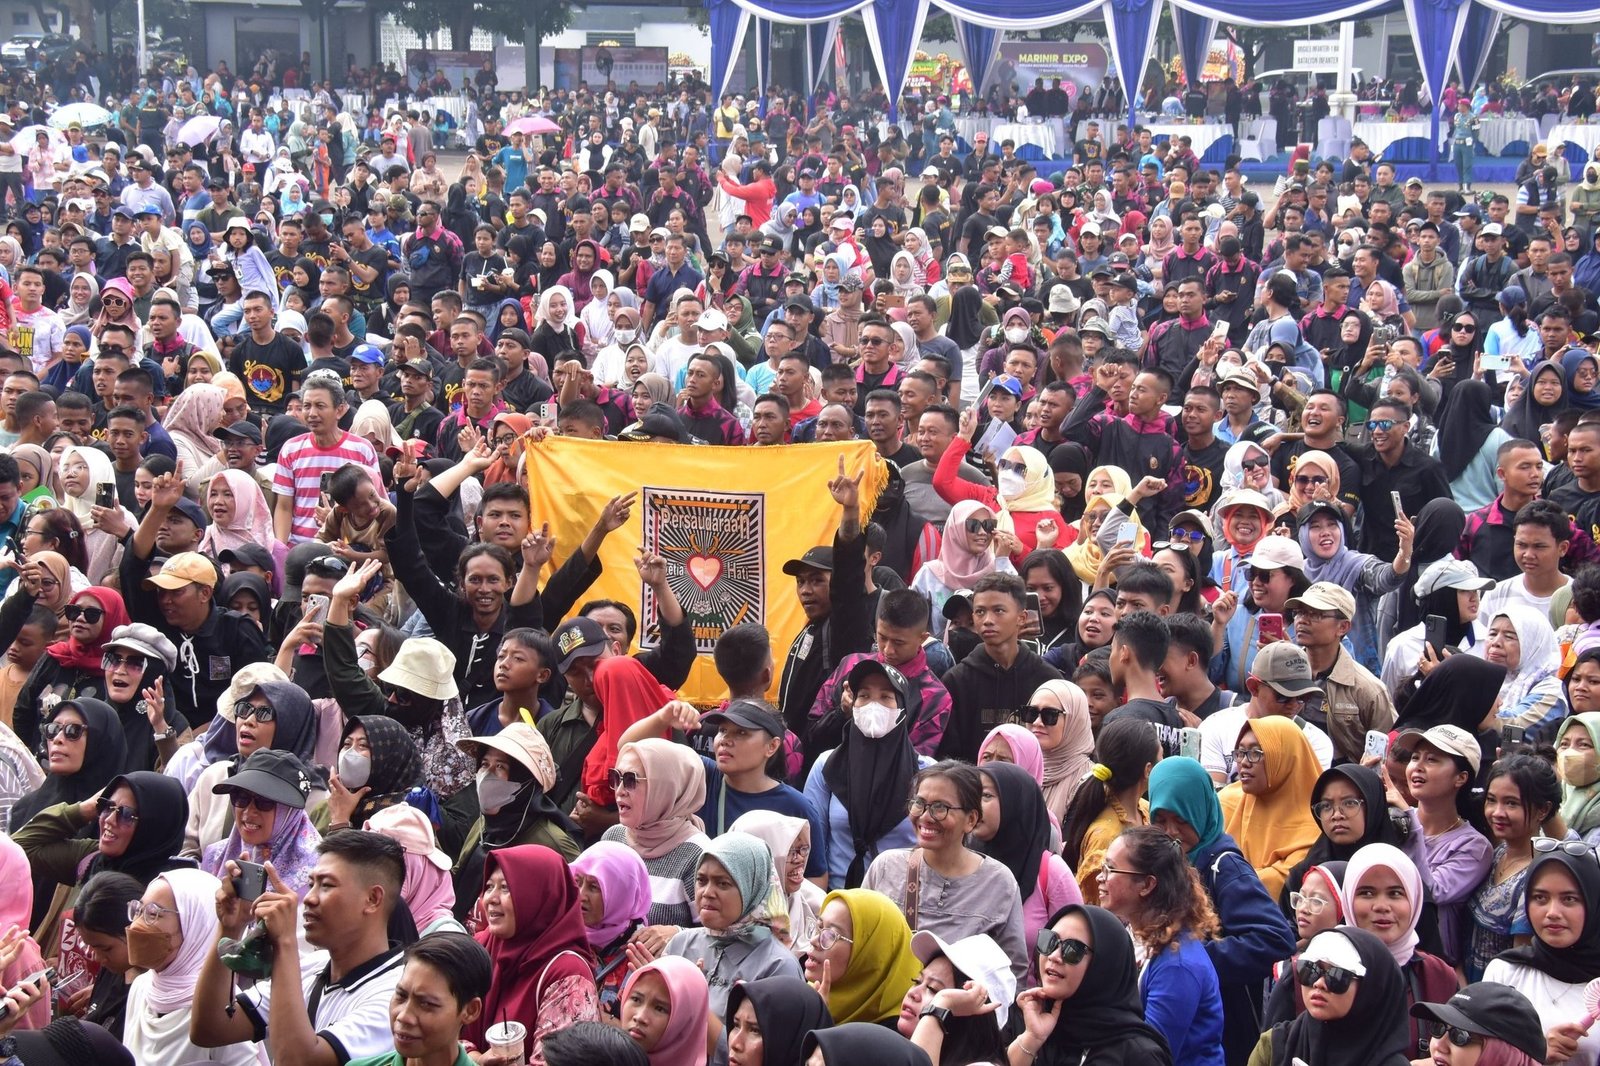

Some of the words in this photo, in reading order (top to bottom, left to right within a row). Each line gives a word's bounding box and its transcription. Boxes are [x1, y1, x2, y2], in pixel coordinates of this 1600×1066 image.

[1018, 53, 1059, 64] MARINIR
[1062, 53, 1088, 64] EXPO
[660, 507, 751, 540] Persaudaraan
[726, 561, 750, 580] Hati
